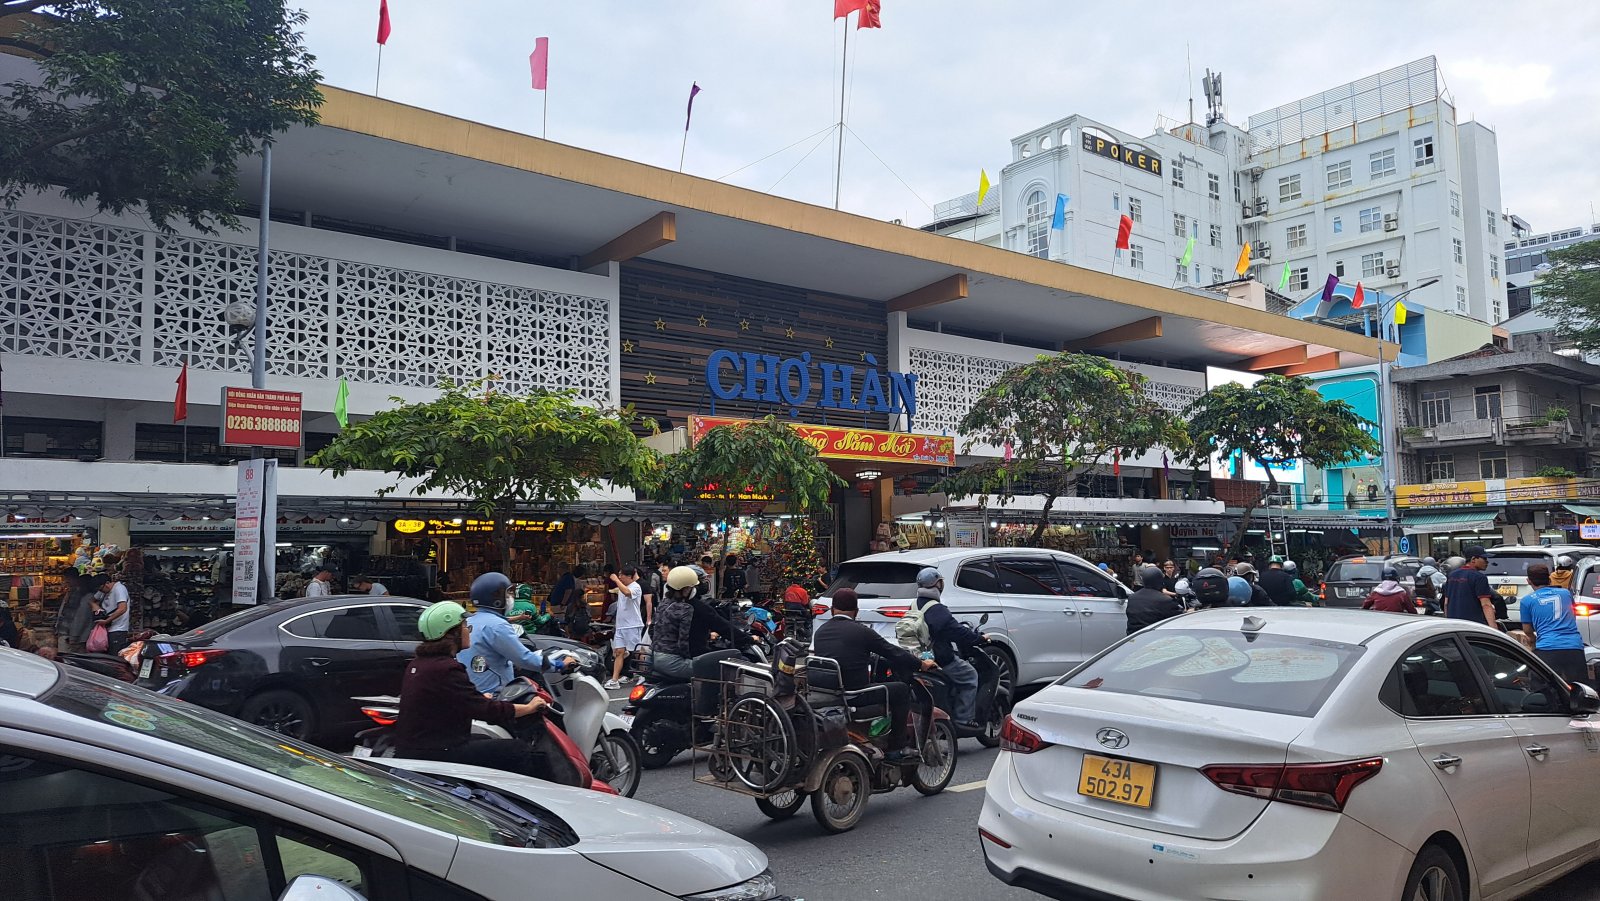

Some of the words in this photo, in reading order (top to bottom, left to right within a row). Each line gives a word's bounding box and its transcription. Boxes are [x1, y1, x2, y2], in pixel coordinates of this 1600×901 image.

[1096, 139, 1159, 173] POKER
[705, 349, 811, 417] CHỢ
[817, 353, 919, 415] HÀN
[227, 415, 300, 433] 0236.3888888
[833, 431, 875, 451] Năm
[878, 434, 917, 456] Mới
[1538, 594, 1563, 621] 7
[1101, 760, 1132, 781] 43A
[1086, 777, 1144, 803] 502.97
